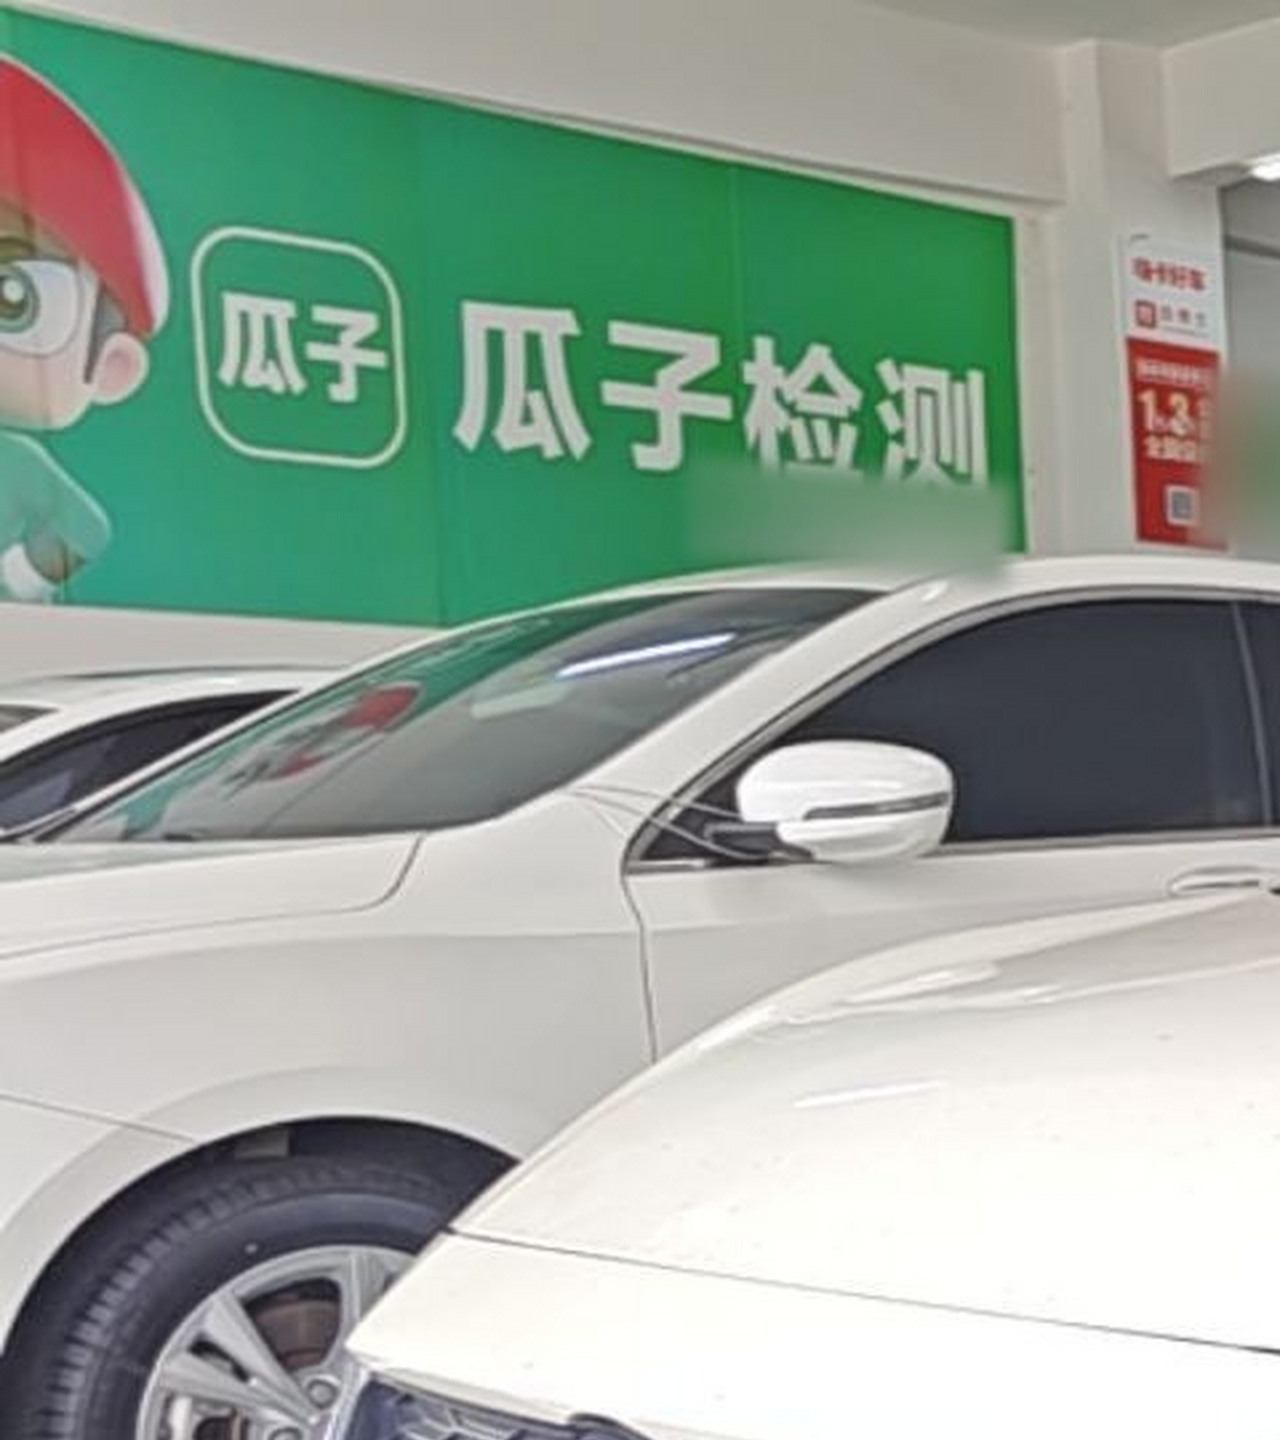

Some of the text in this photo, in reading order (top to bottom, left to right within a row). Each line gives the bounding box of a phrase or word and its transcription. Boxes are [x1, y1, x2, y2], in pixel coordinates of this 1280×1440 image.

[217, 291, 388, 402] 瓜子
[452, 299, 990, 486] 瓜子检测
